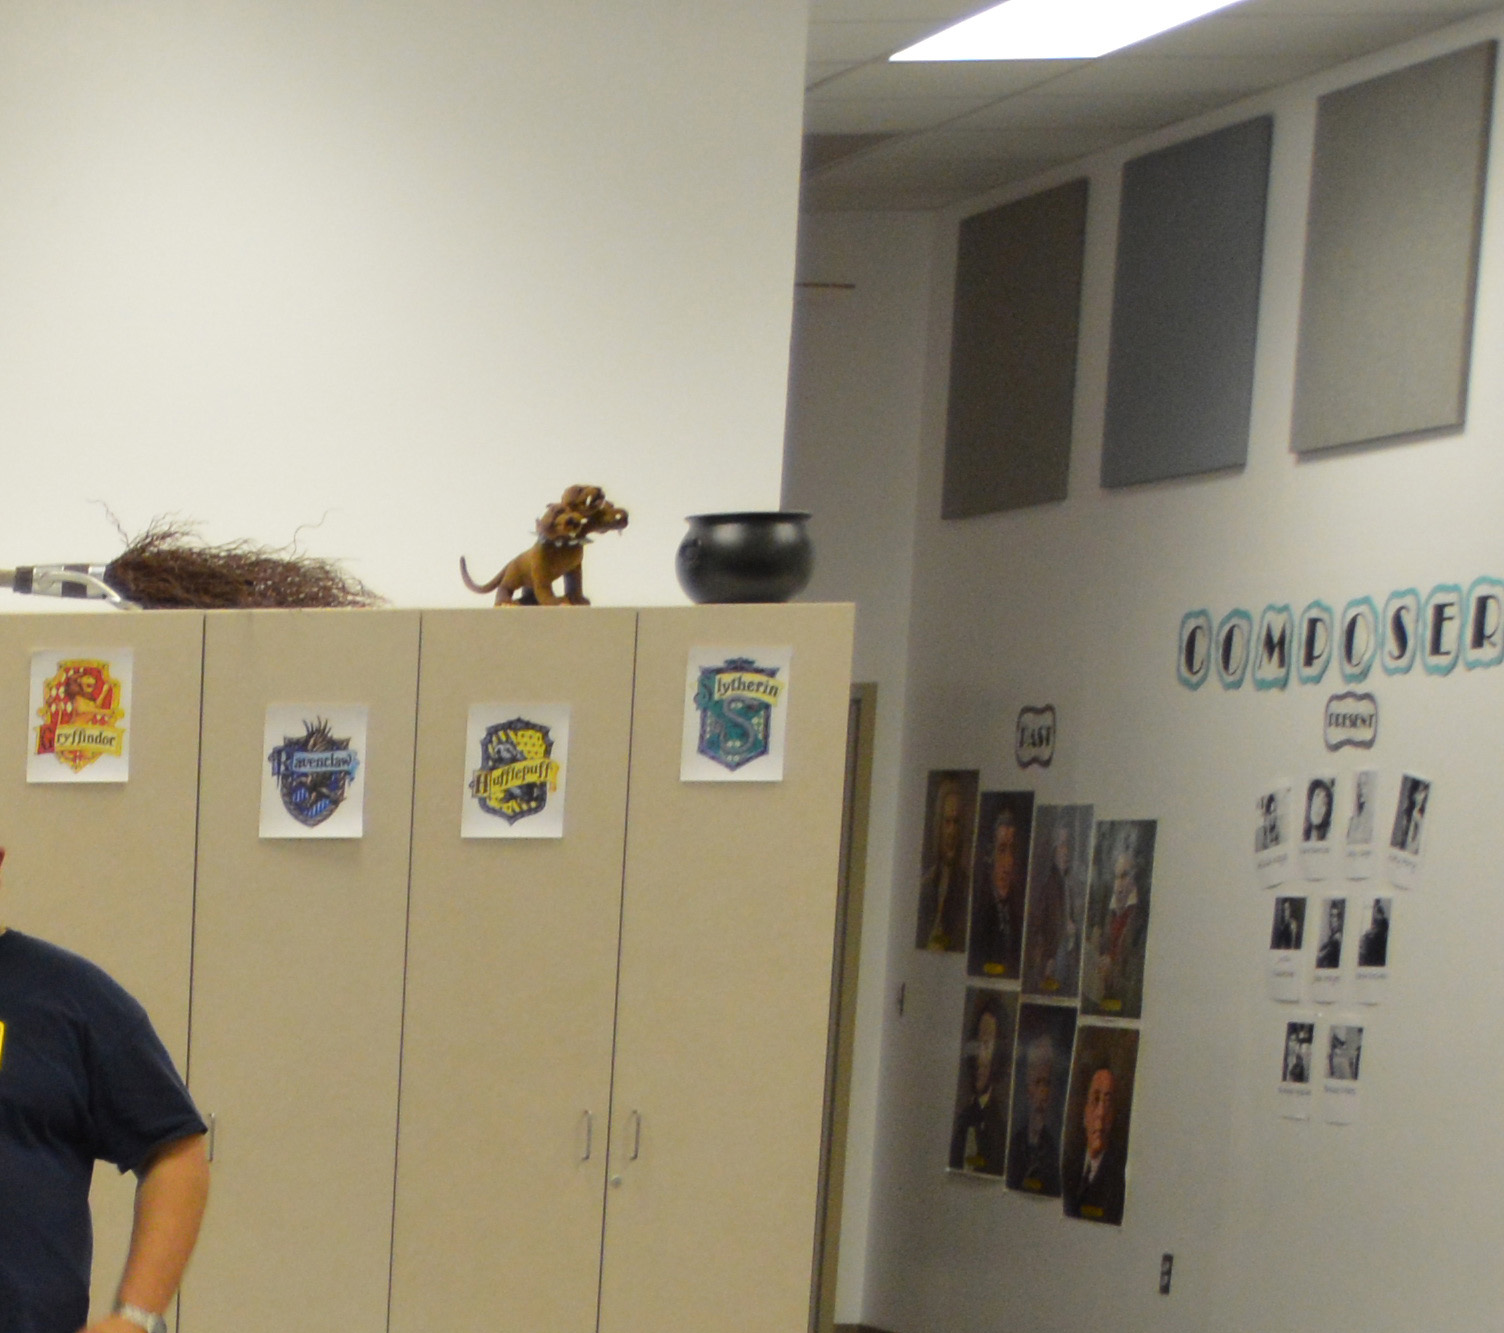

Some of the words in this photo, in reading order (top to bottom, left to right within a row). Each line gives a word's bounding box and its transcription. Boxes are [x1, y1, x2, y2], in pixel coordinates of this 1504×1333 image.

[695, 674, 779, 709] Slytherin
[1328, 712, 1375, 729] PRESENT
[41, 727, 116, 752] Gryffindor
[272, 747, 352, 773] Ravenclaw
[474, 760, 552, 796] Hufflepuff
